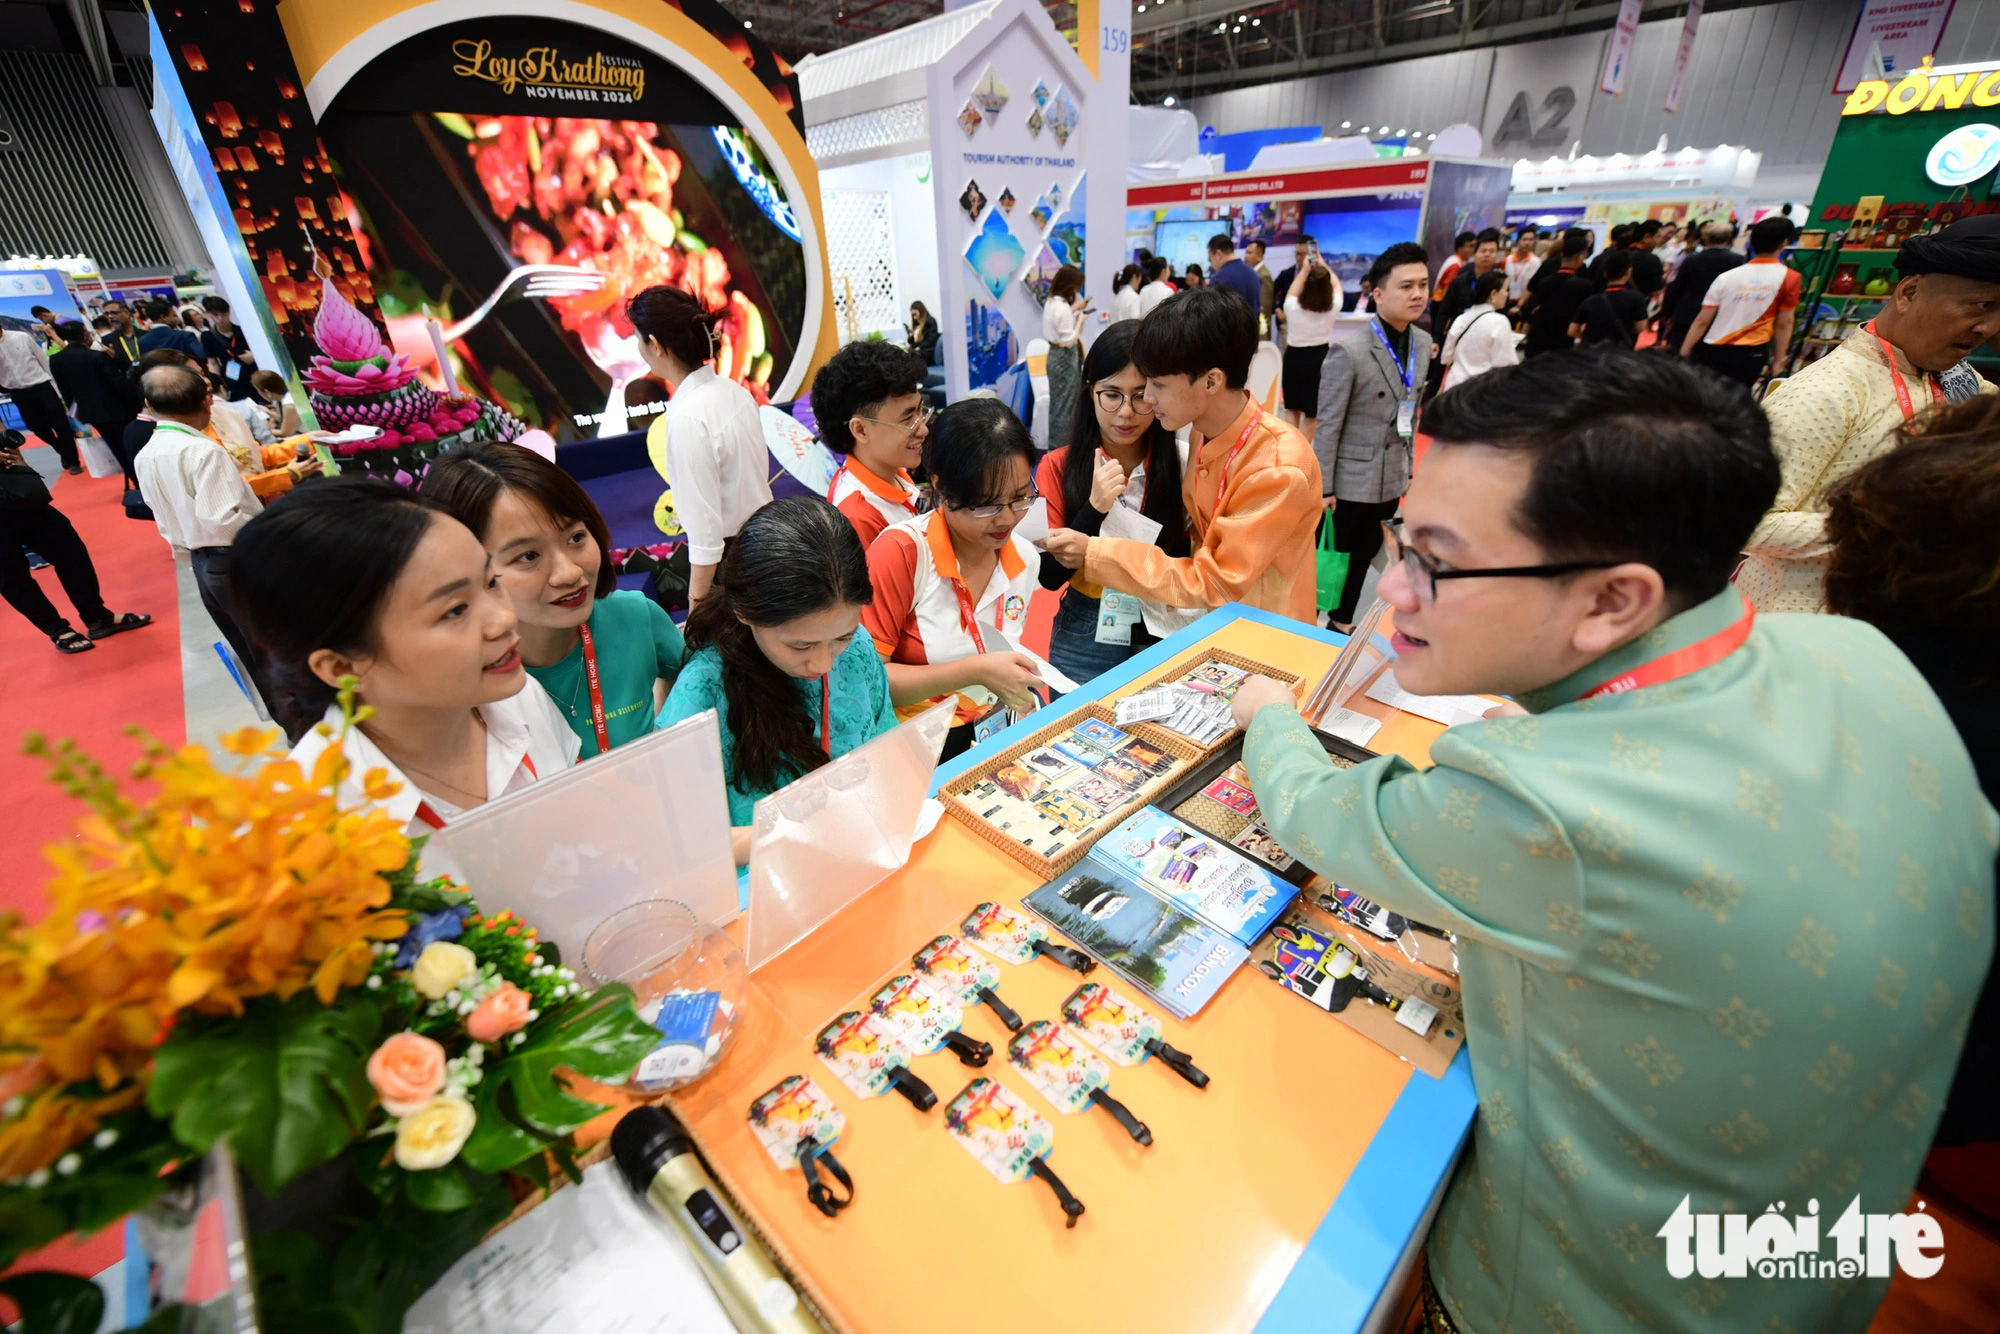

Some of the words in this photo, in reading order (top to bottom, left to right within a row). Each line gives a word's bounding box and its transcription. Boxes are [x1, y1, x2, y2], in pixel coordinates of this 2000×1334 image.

[1888, 1, 1945, 13] LIVESTREAM
[1871, 19, 1929, 33] LIVESTREAM
[1883, 31, 1908, 40] AREA
[1103, 26, 1127, 54] 159
[452, 39, 522, 95] Loy
[518, 46, 646, 101] Krathong
[601, 55, 643, 69] FESTIVAL
[525, 86, 599, 102] NOVEMBER
[601, 90, 633, 104] 2024
[1492, 86, 1576, 150] A2
[963, 153, 995, 164] TOURISM
[997, 155, 1034, 166] AUTHORITY
[1035, 157, 1044, 166] OF
[1045, 157, 1075, 168] THAILAND
[1231, 182, 1258, 193] AVIATION
[1901, 398, 1909, 408] ITE
[961, 599, 969, 609] ITE
[965, 608, 974, 624] HCMC
[583, 633, 591, 645] ITE
[588, 659, 596, 678] HCMC
[594, 703, 603, 723] HCMC
[597, 724, 605, 734] ITE
[1221, 877, 1257, 908] Bangkok
[1174, 944, 1230, 998] BANGKOK
[961, 983, 983, 1001] BKK
[922, 1026, 944, 1047] BKK
[1127, 1038, 1149, 1058] BKK
[1068, 1082, 1090, 1104] BKK
[1010, 1147, 1033, 1173] BKK
